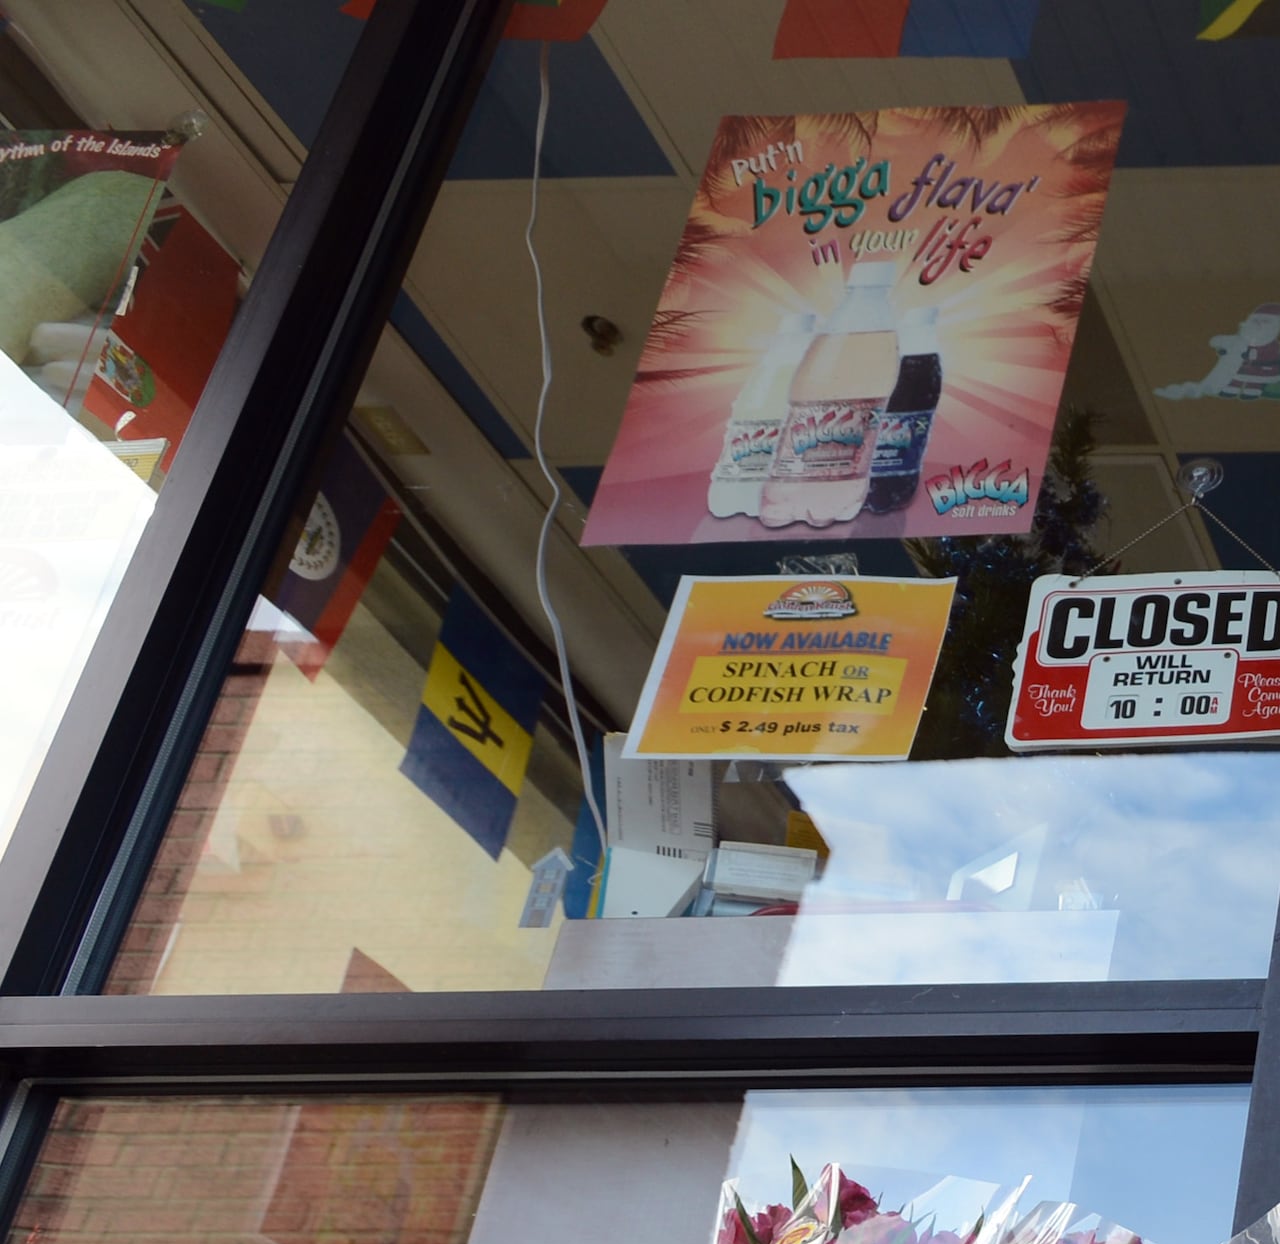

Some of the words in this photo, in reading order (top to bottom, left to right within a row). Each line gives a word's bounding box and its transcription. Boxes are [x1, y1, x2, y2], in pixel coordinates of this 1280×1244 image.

[51, 135, 73, 152] of
[76, 136, 104, 152] the
[731, 141, 804, 186] put'n
[752, 156, 891, 233] bigga
[888, 152, 1041, 222] flava'
[809, 238, 840, 266] in
[849, 227, 919, 262] your
[911, 216, 993, 285] life
[925, 458, 1030, 516] BIGGA
[951, 504, 974, 518] soft
[977, 504, 1017, 518] drinks
[722, 632, 779, 651] NOW
[780, 631, 893, 651] AVAILABLE
[722, 660, 839, 679] SPINACH
[842, 665, 870, 679] OR
[1136, 654, 1193, 670] WILL
[1112, 669, 1211, 687] RETURN
[688, 685, 805, 705] CODFISH
[813, 686, 893, 706] WRAP
[1027, 683, 1077, 700] Thank
[1034, 699, 1077, 718] You!
[719, 720, 733, 734] $
[737, 721, 778, 735] 2.49
[783, 721, 821, 737] plus
[828, 722, 860, 735] tax
